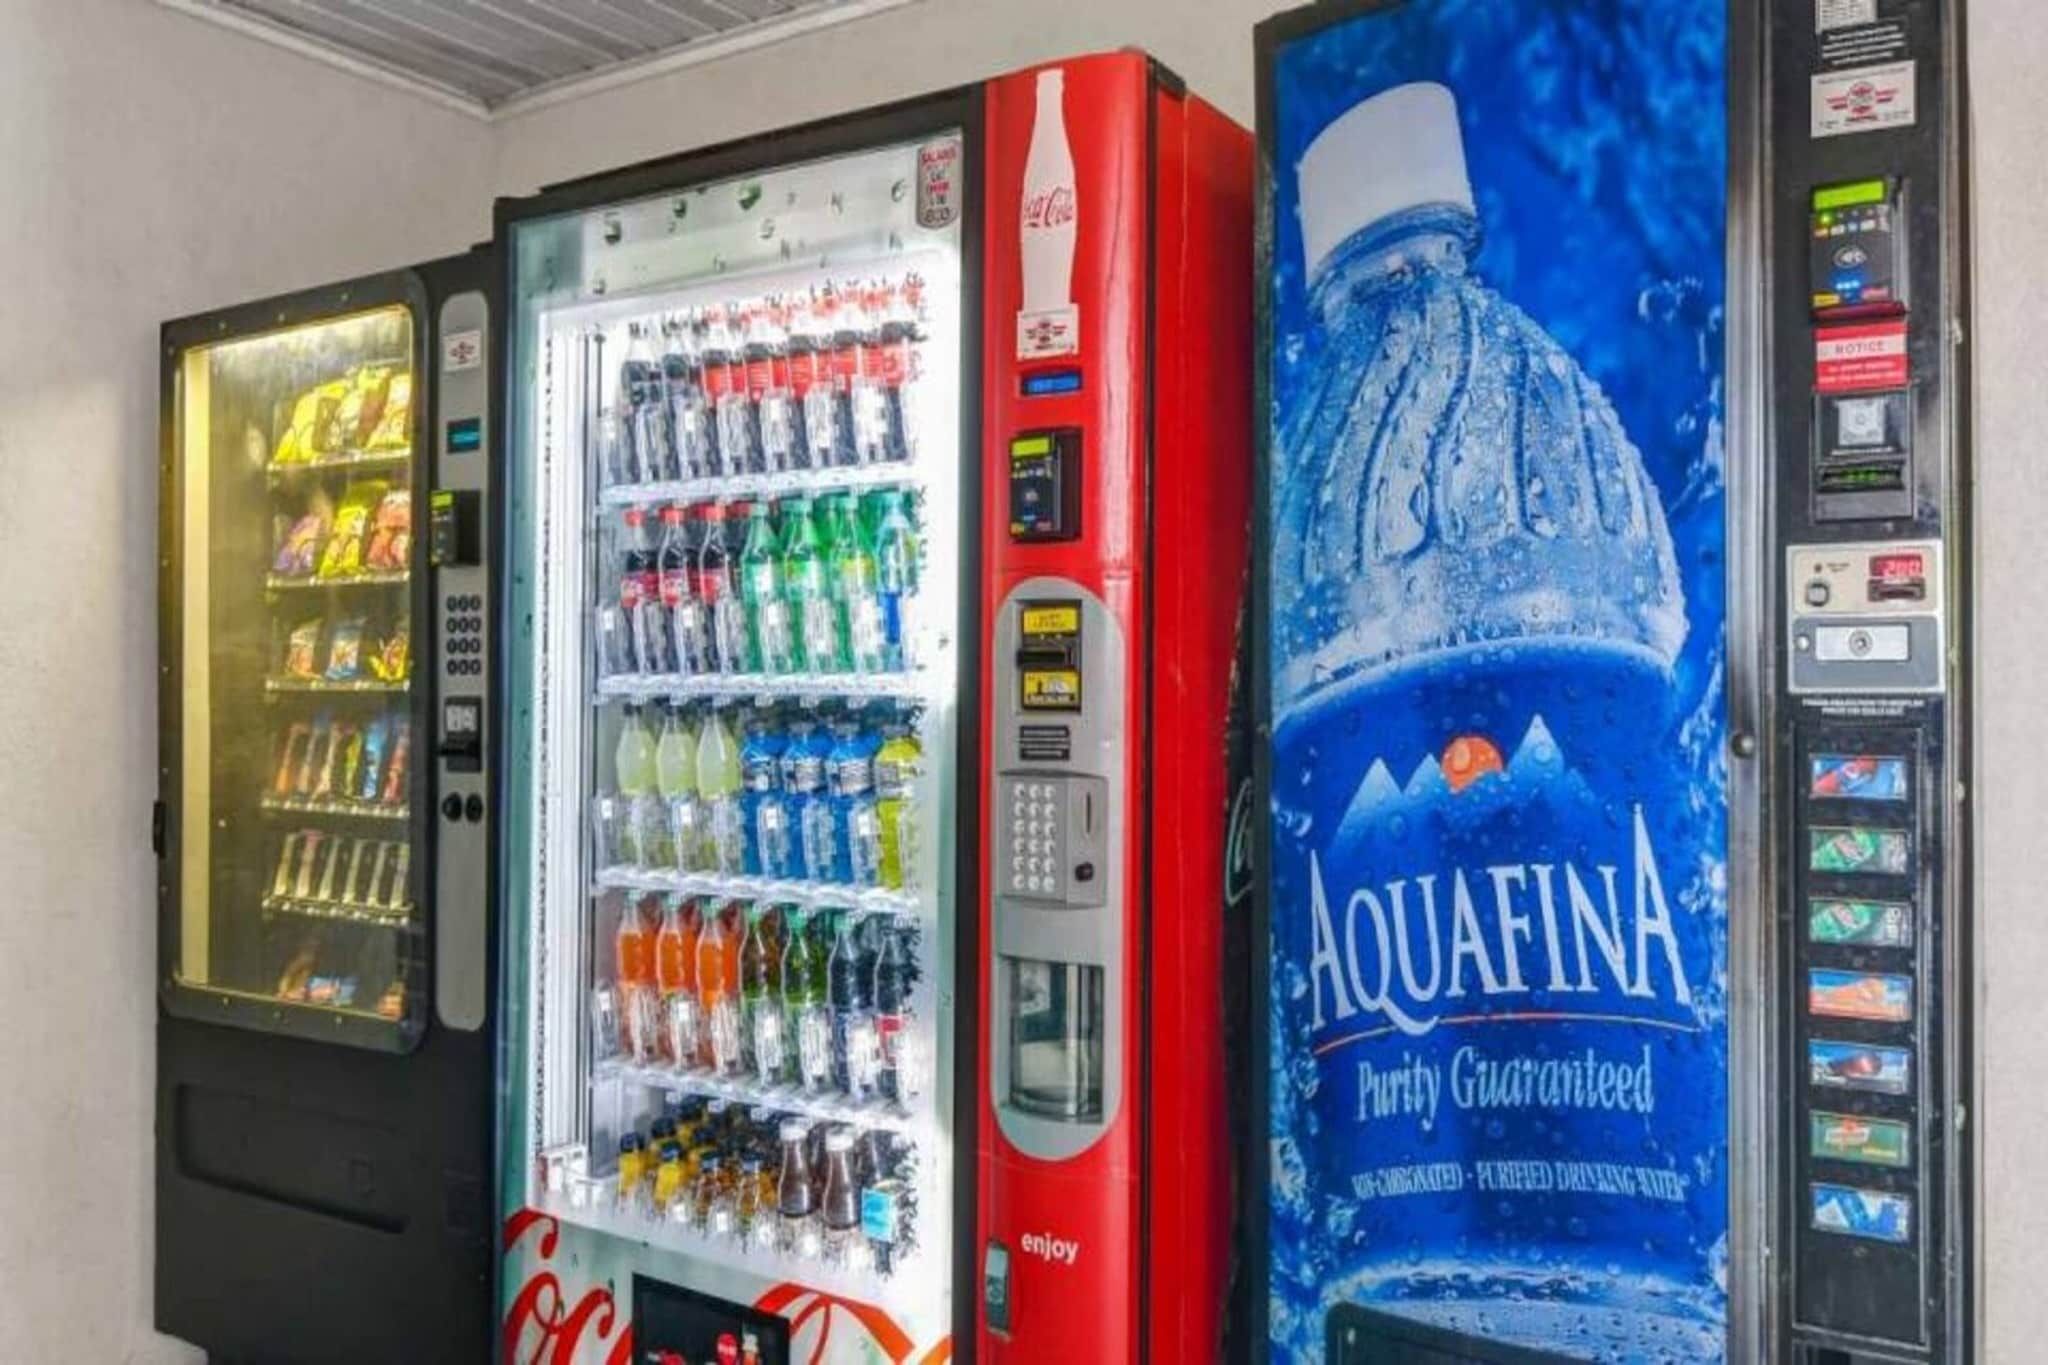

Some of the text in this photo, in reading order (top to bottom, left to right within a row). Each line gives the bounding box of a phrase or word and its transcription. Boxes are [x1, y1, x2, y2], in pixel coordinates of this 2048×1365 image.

[1835, 340, 1886, 354] NOTICE
[1311, 803, 1692, 1035] AQUAFINA
[1358, 1045, 1656, 1130] Purity Guaranteed
[1476, 1160, 1553, 1191] PURIFIED
[1555, 1160, 1636, 1196] DRINKING
[1021, 1231, 1079, 1264] enjoy
